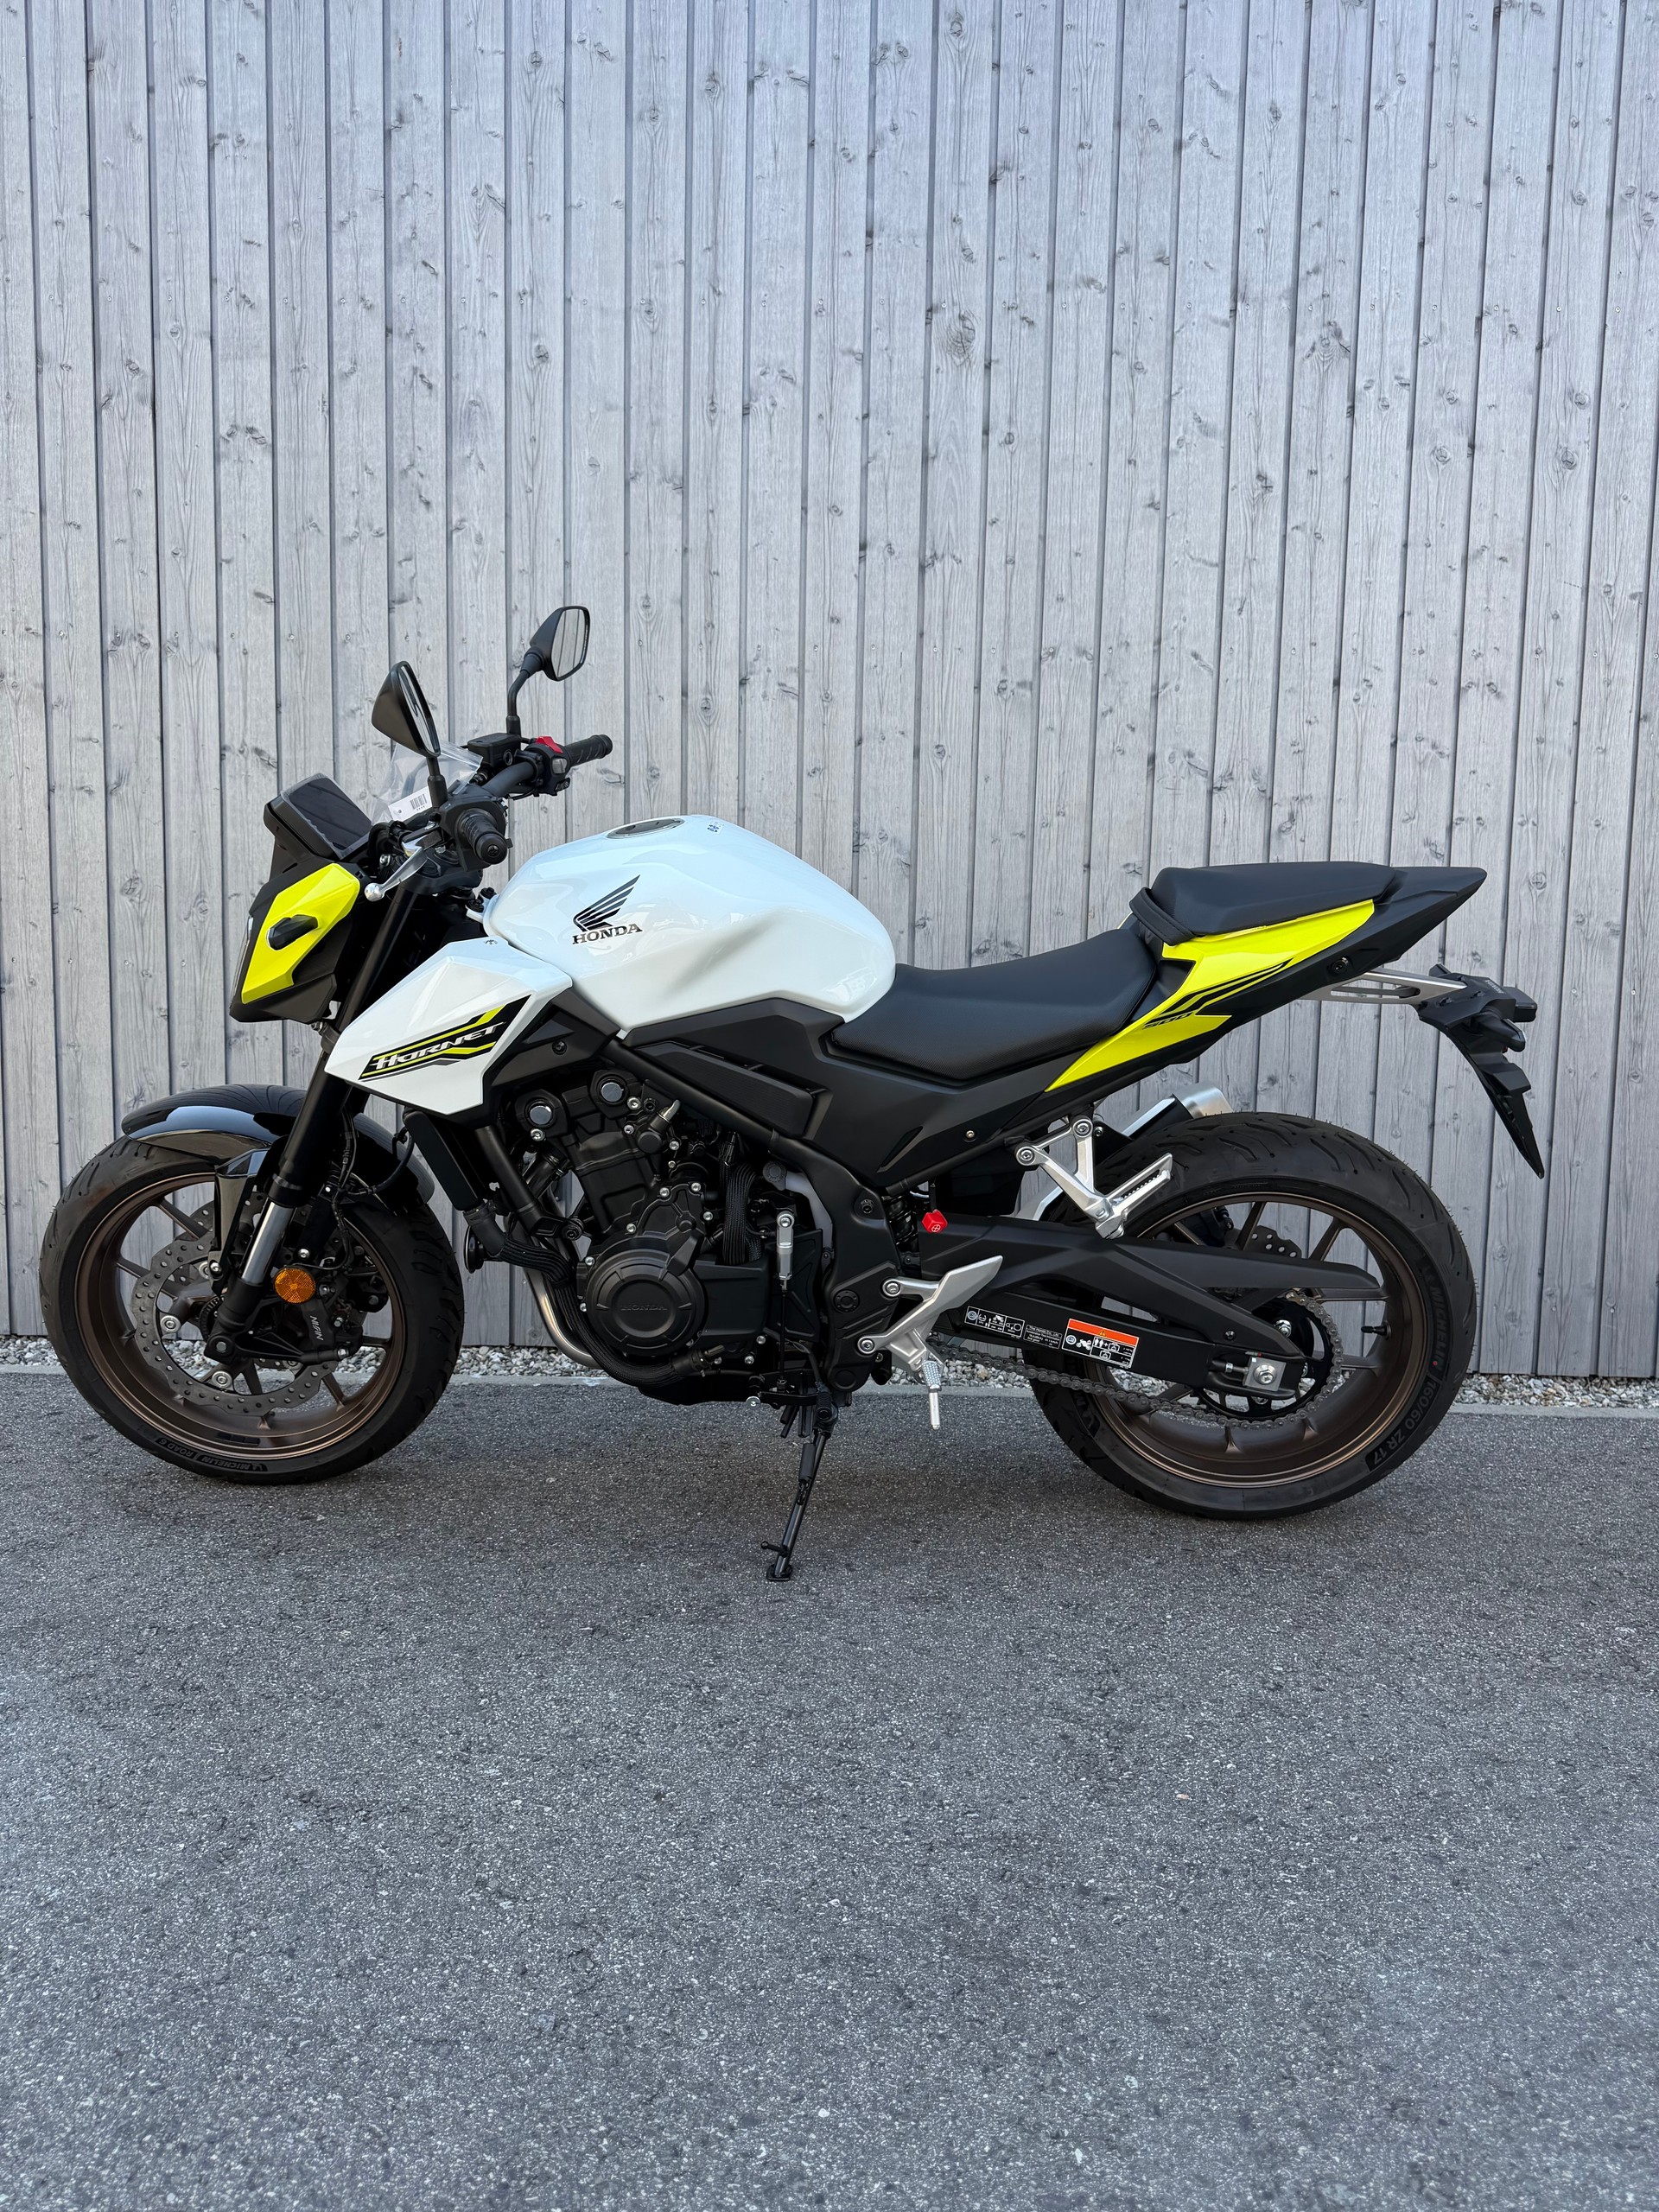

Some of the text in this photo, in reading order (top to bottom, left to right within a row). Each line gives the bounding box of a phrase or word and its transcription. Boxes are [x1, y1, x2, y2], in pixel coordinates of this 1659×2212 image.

[572, 923, 643, 944] HONDA
[1430, 1286, 1446, 1371] MICHELIN
[1374, 1382, 1437, 1465] 160/60 ZR 17
[201, 1456, 251, 1470] MICHELIN
